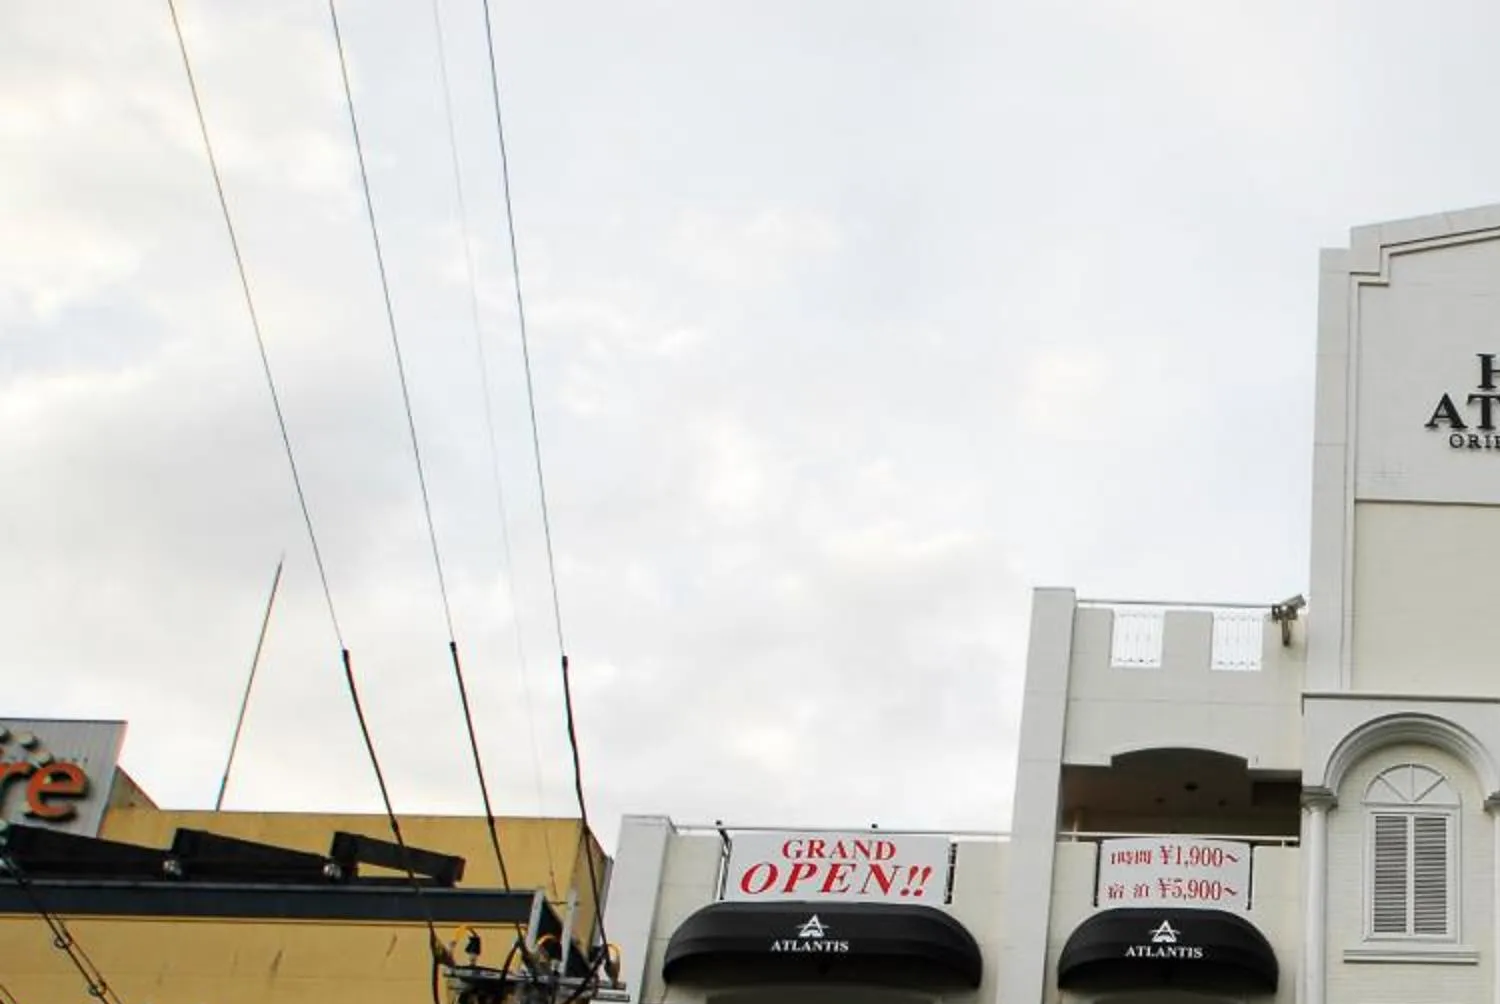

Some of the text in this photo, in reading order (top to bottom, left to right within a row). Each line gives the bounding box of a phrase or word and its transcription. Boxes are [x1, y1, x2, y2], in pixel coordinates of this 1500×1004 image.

[781, 838, 896, 860] GRAND
[740, 861, 932, 897] OPEN!!
[771, 939, 849, 952] ATLANTIS
[1125, 945, 1203, 959] ATLANTIS
